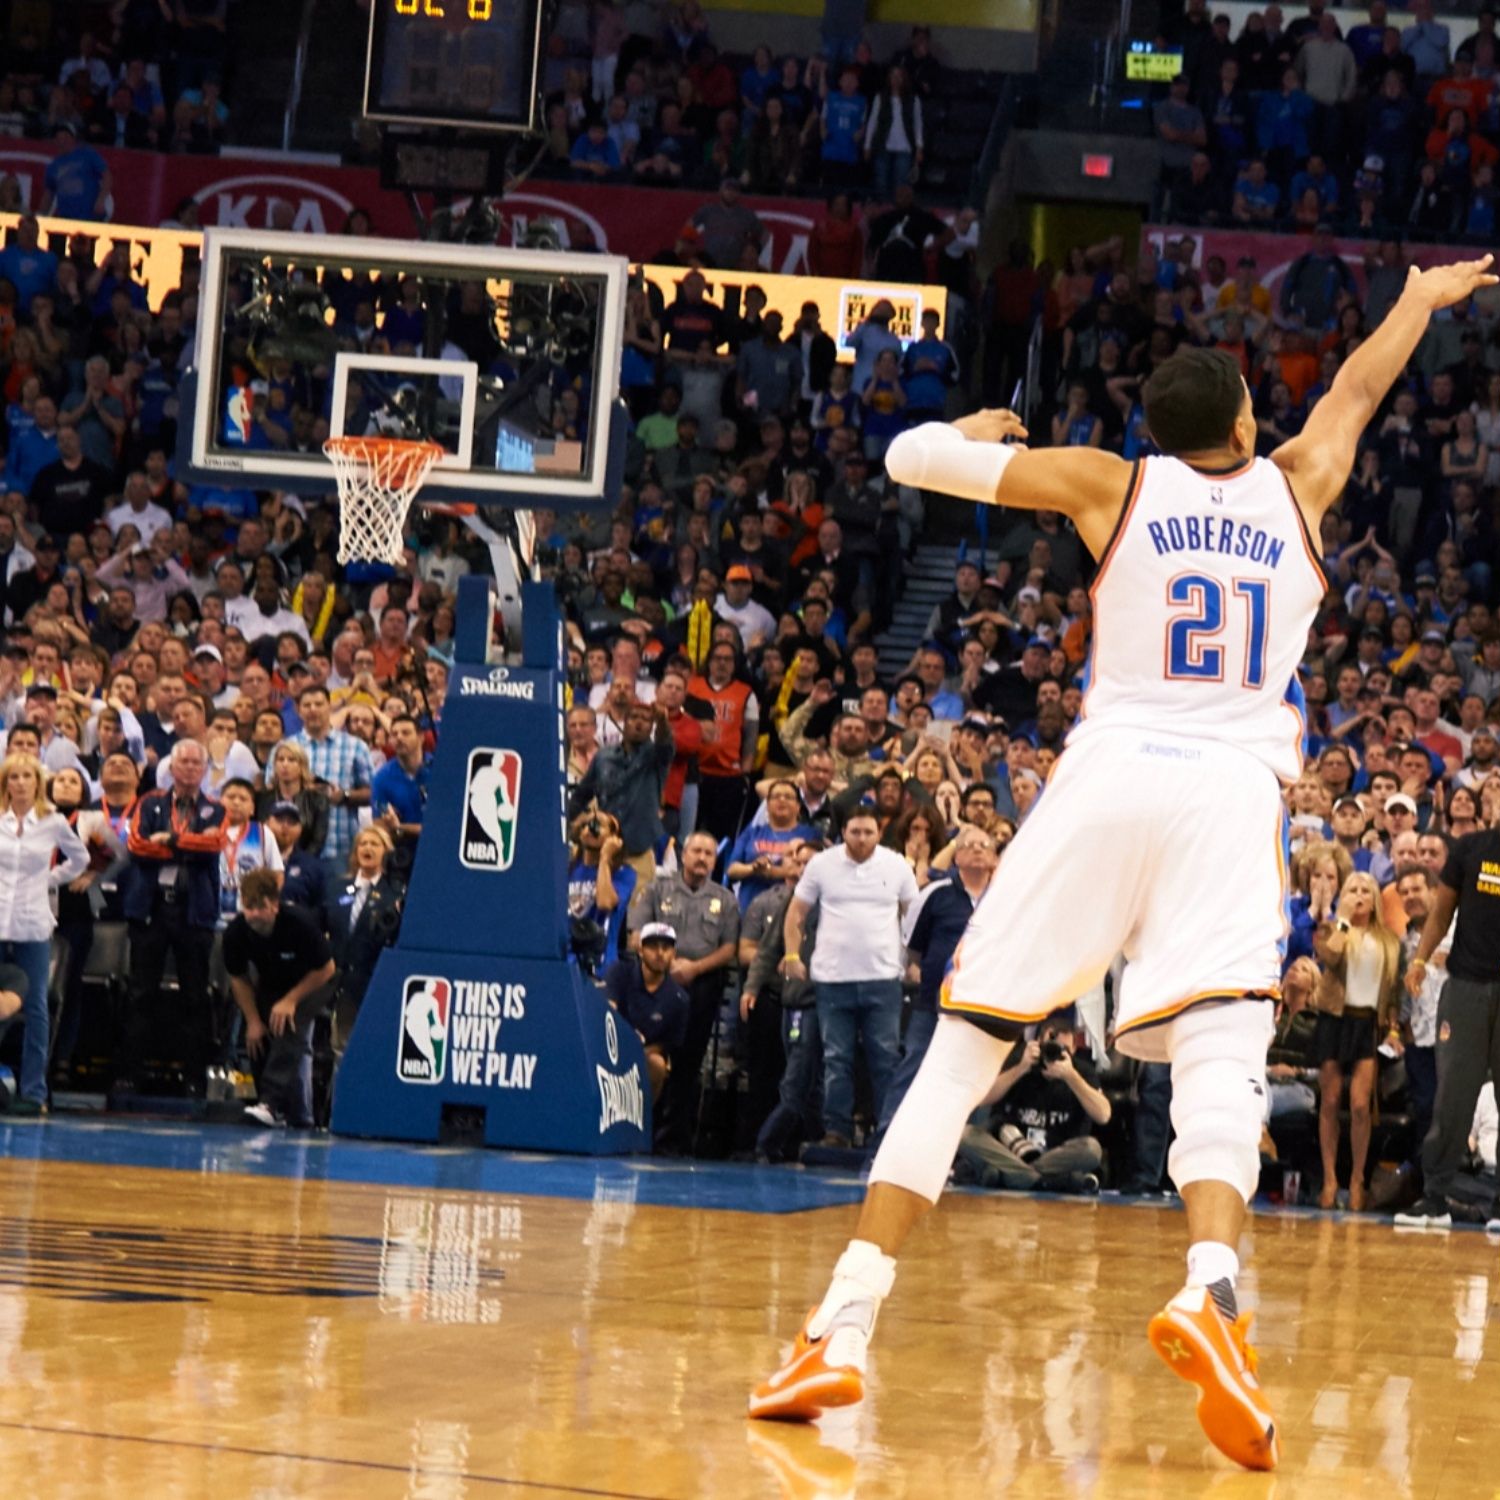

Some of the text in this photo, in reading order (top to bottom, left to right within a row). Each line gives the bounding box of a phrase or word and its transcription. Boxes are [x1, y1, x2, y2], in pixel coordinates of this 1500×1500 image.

[1147, 516, 1285, 569] ROBERSON
[1164, 569, 1271, 690] 21
[460, 675, 534, 701] SPALDING
[466, 842, 497, 861] NBA
[454, 980, 526, 1020] THIS IS
[453, 1015, 501, 1052] WHY
[403, 1058, 429, 1077] NBA
[452, 1050, 538, 1090] WE PLAY
[597, 1063, 644, 1134] SPALDING
